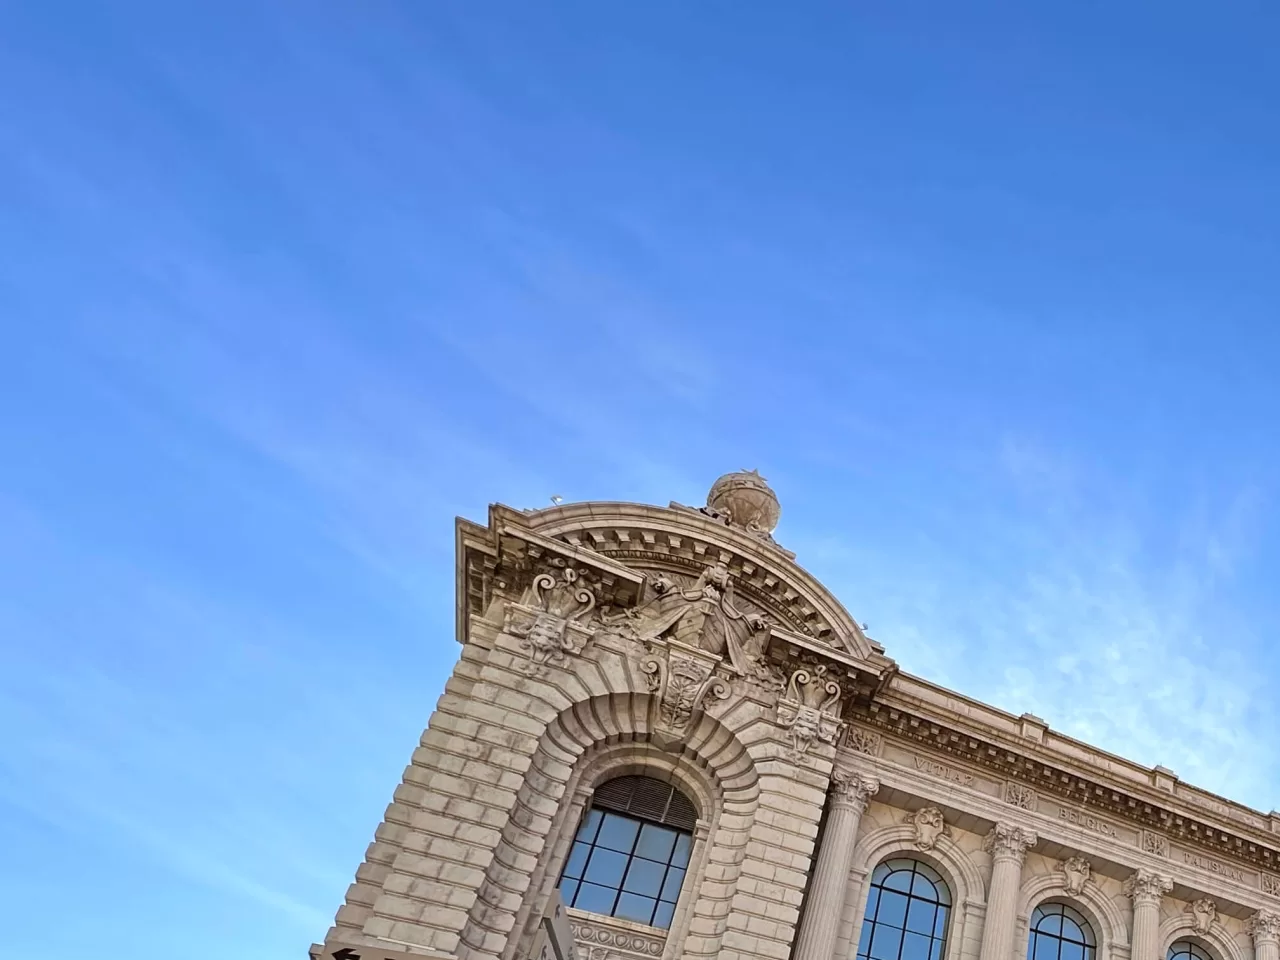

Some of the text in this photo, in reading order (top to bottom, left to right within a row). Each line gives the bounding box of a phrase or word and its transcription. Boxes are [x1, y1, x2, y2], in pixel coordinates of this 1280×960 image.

[913, 755, 974, 787] VITIAZ
[1057, 806, 1118, 838] BELGICA
[1183, 852, 1245, 883] TALISMAN
